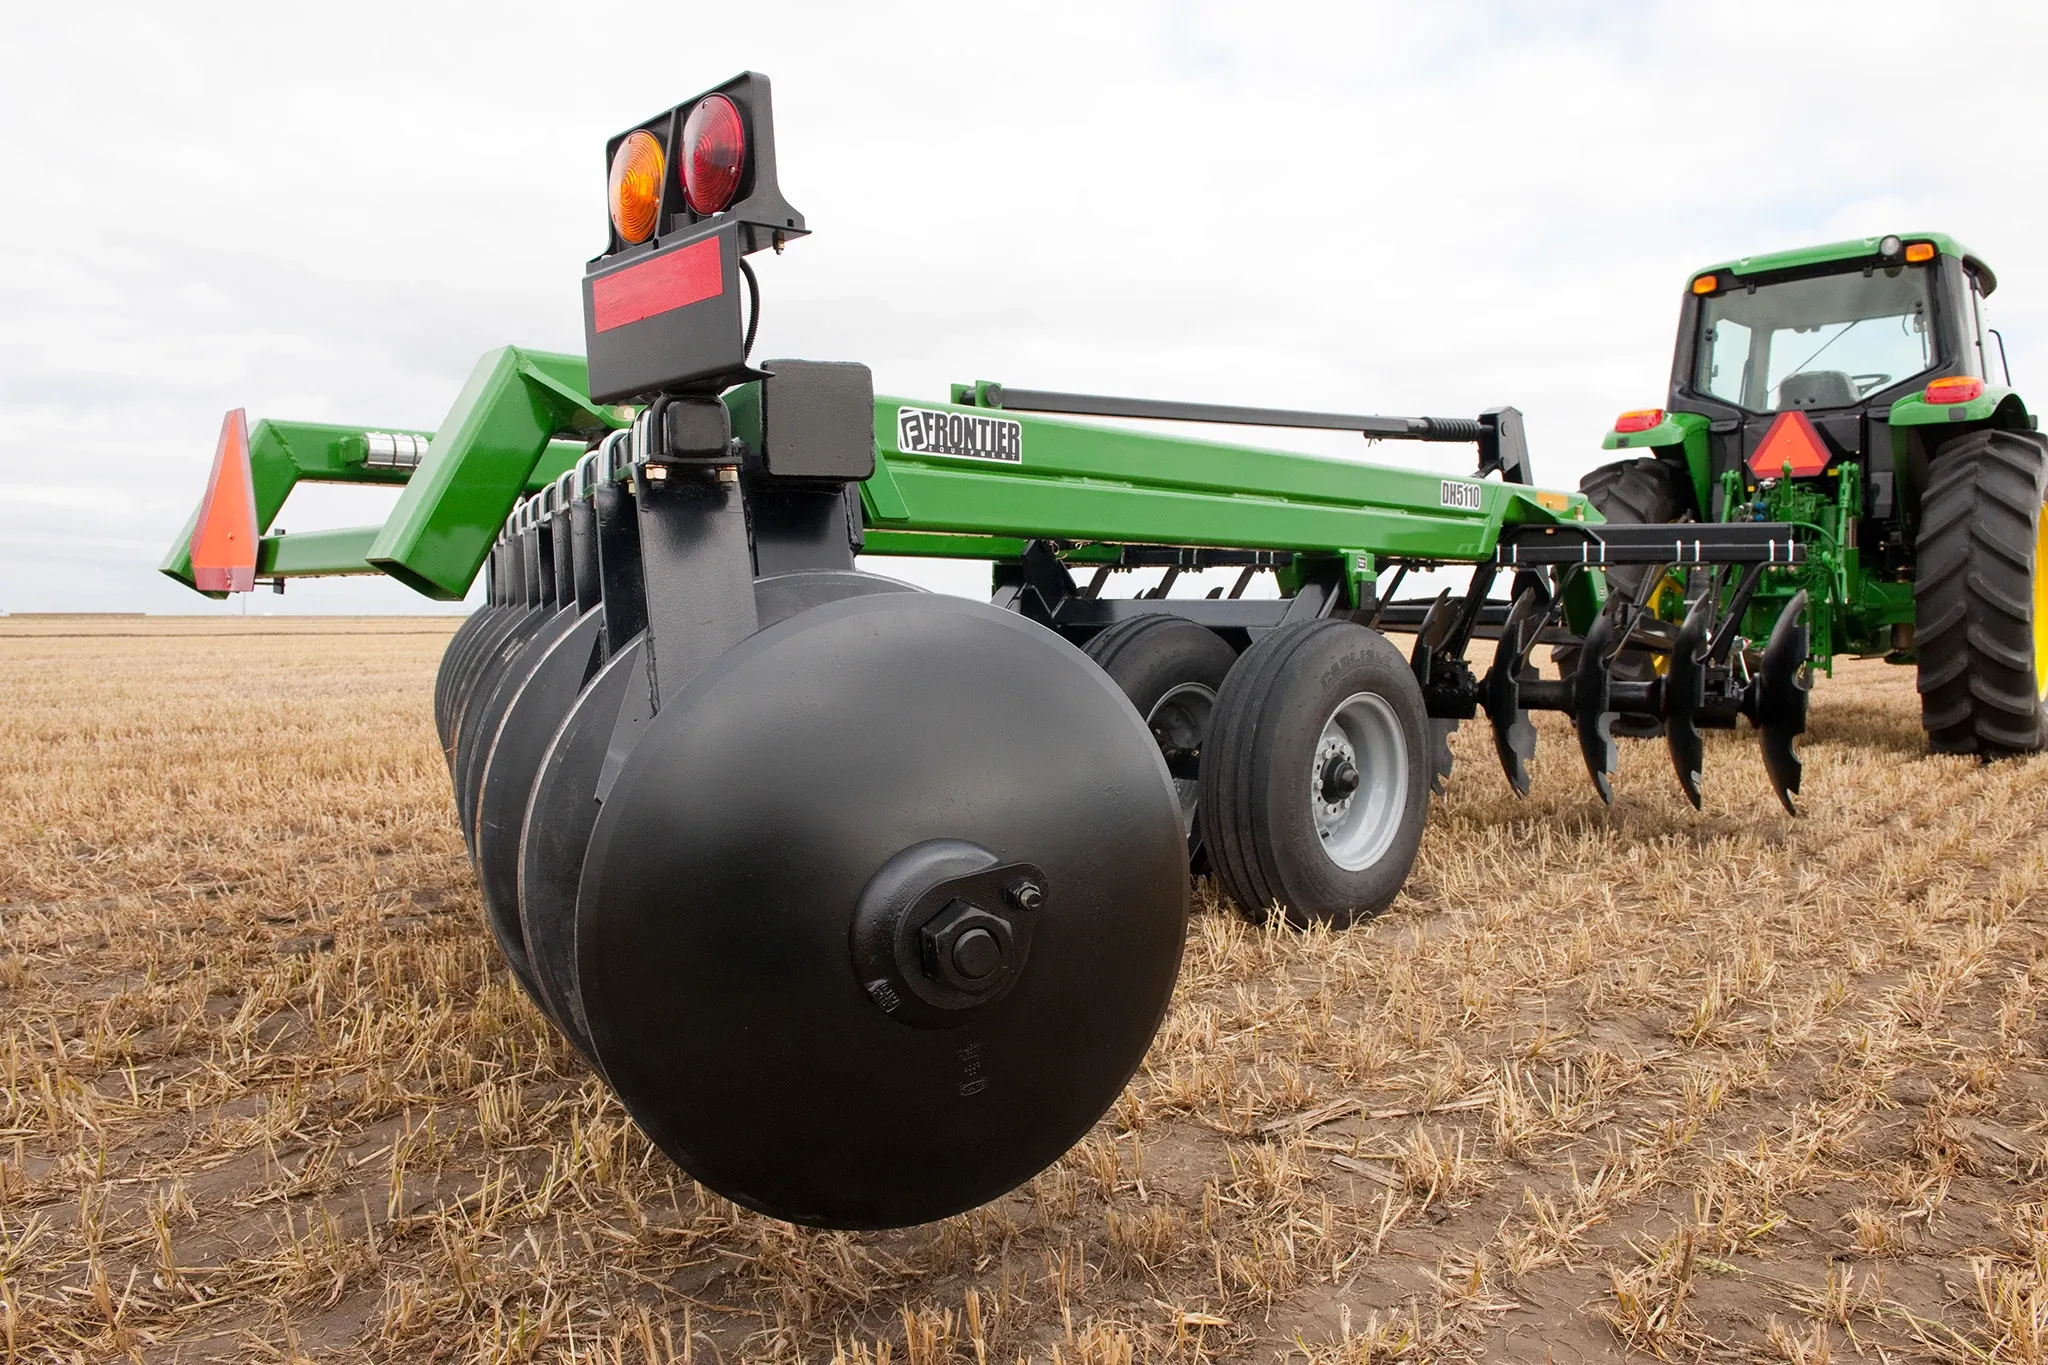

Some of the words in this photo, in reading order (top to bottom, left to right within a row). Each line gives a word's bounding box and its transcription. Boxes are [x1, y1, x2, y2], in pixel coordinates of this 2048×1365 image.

[922, 411, 1020, 455] FRONTIER
[928, 446, 1016, 460] EQUIPMENT
[1442, 482, 1480, 508] DH5110
